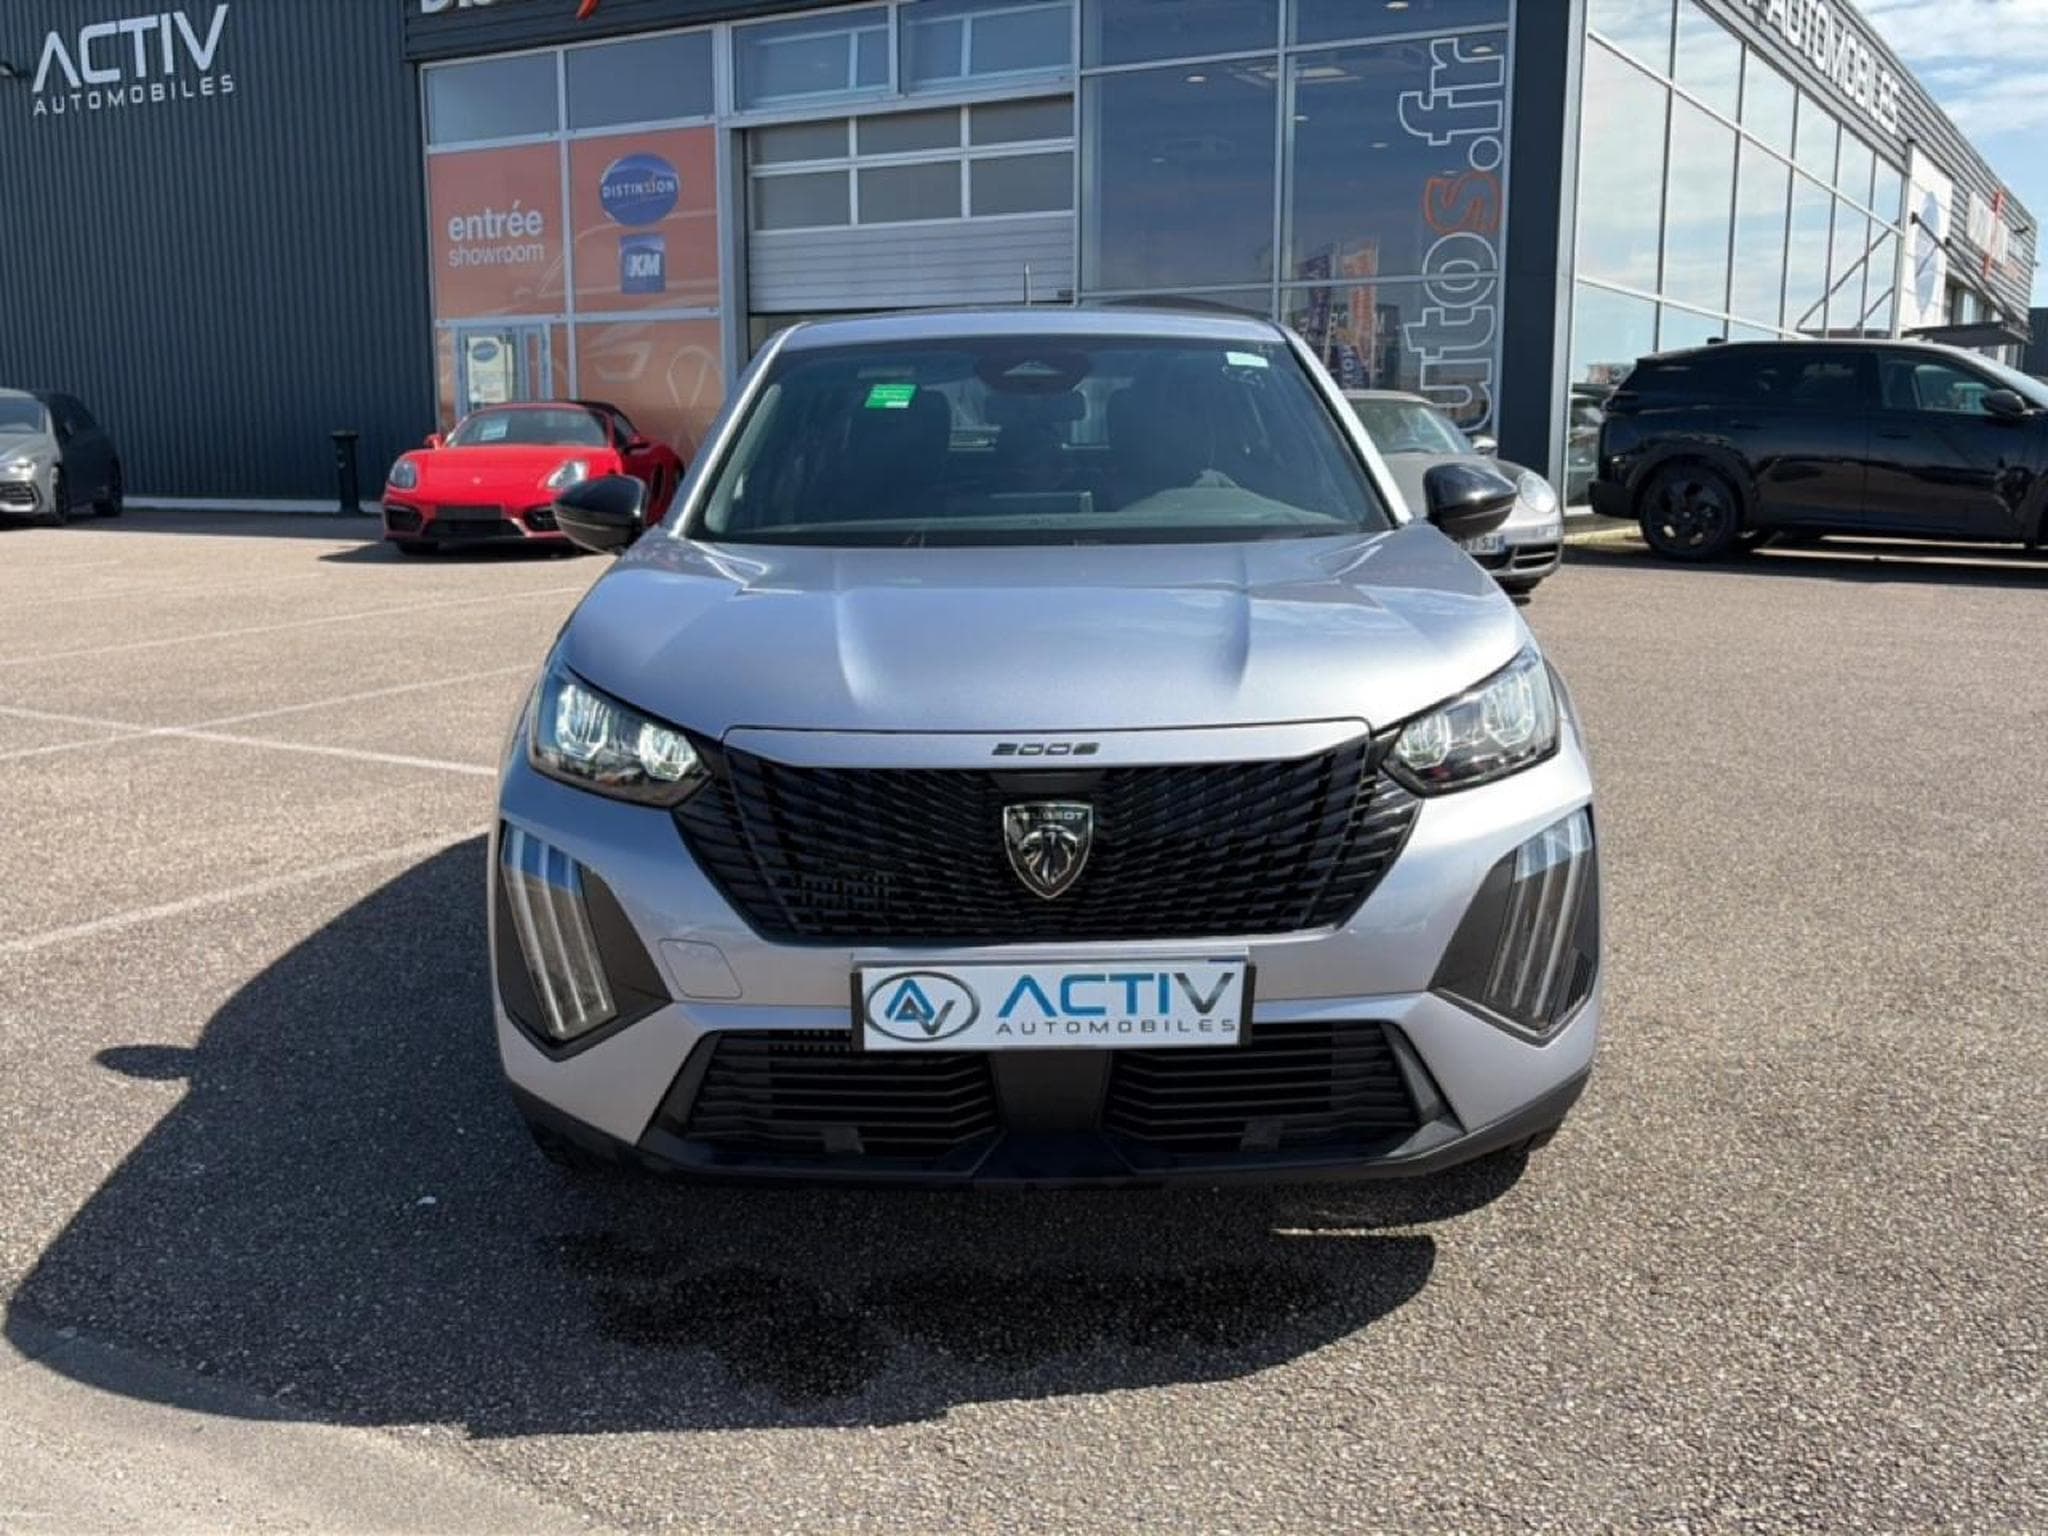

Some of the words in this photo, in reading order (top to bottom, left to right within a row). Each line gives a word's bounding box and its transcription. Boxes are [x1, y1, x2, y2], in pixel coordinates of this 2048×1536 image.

[32, 4, 229, 93] ACTIV
[33, 74, 235, 117] AUTOMOBILES
[448, 200, 544, 241] entrée
[1400, 37, 1505, 433] utos.fr
[448, 243, 545, 267] showroom
[997, 972, 1235, 1018] ACTIV
[995, 1018, 1236, 1036] AUTOMOBILES
